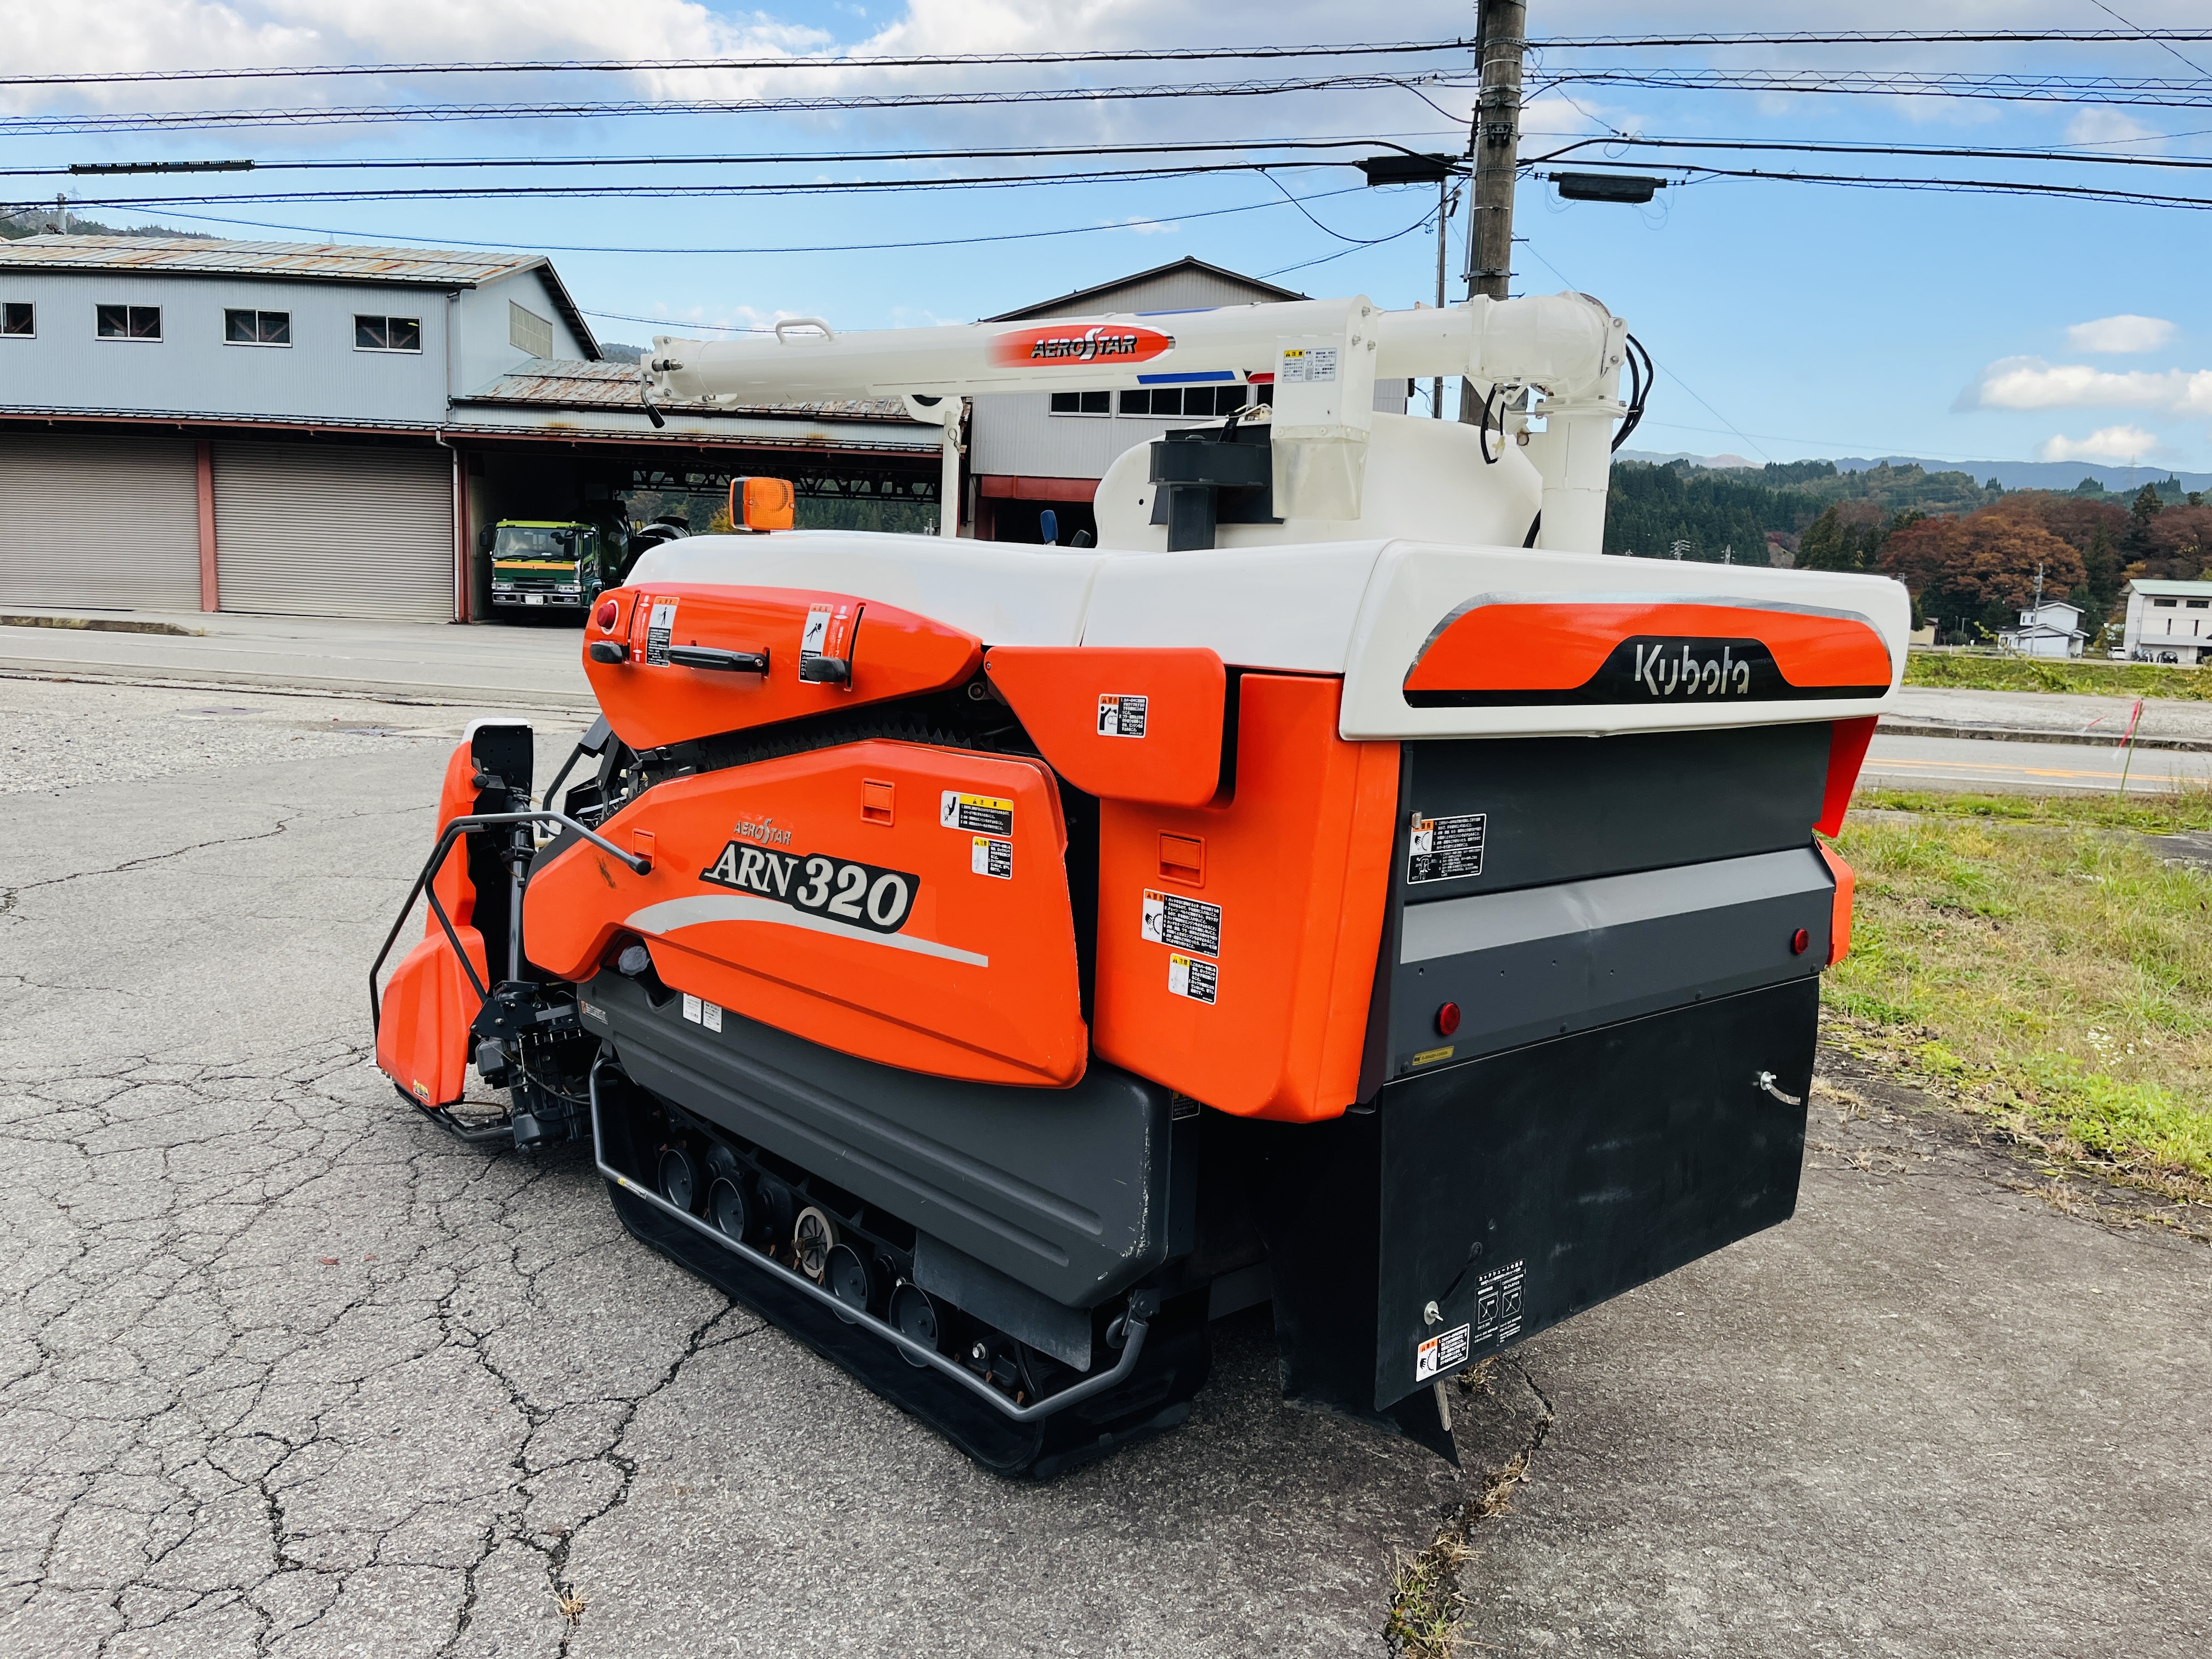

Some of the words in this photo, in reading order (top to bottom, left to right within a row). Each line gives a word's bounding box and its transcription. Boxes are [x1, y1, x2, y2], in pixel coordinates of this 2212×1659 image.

[1030, 327, 1138, 360] AEROSTAR
[1634, 644, 1750, 696] Kubota
[733, 818, 792, 845] AEROSTAR
